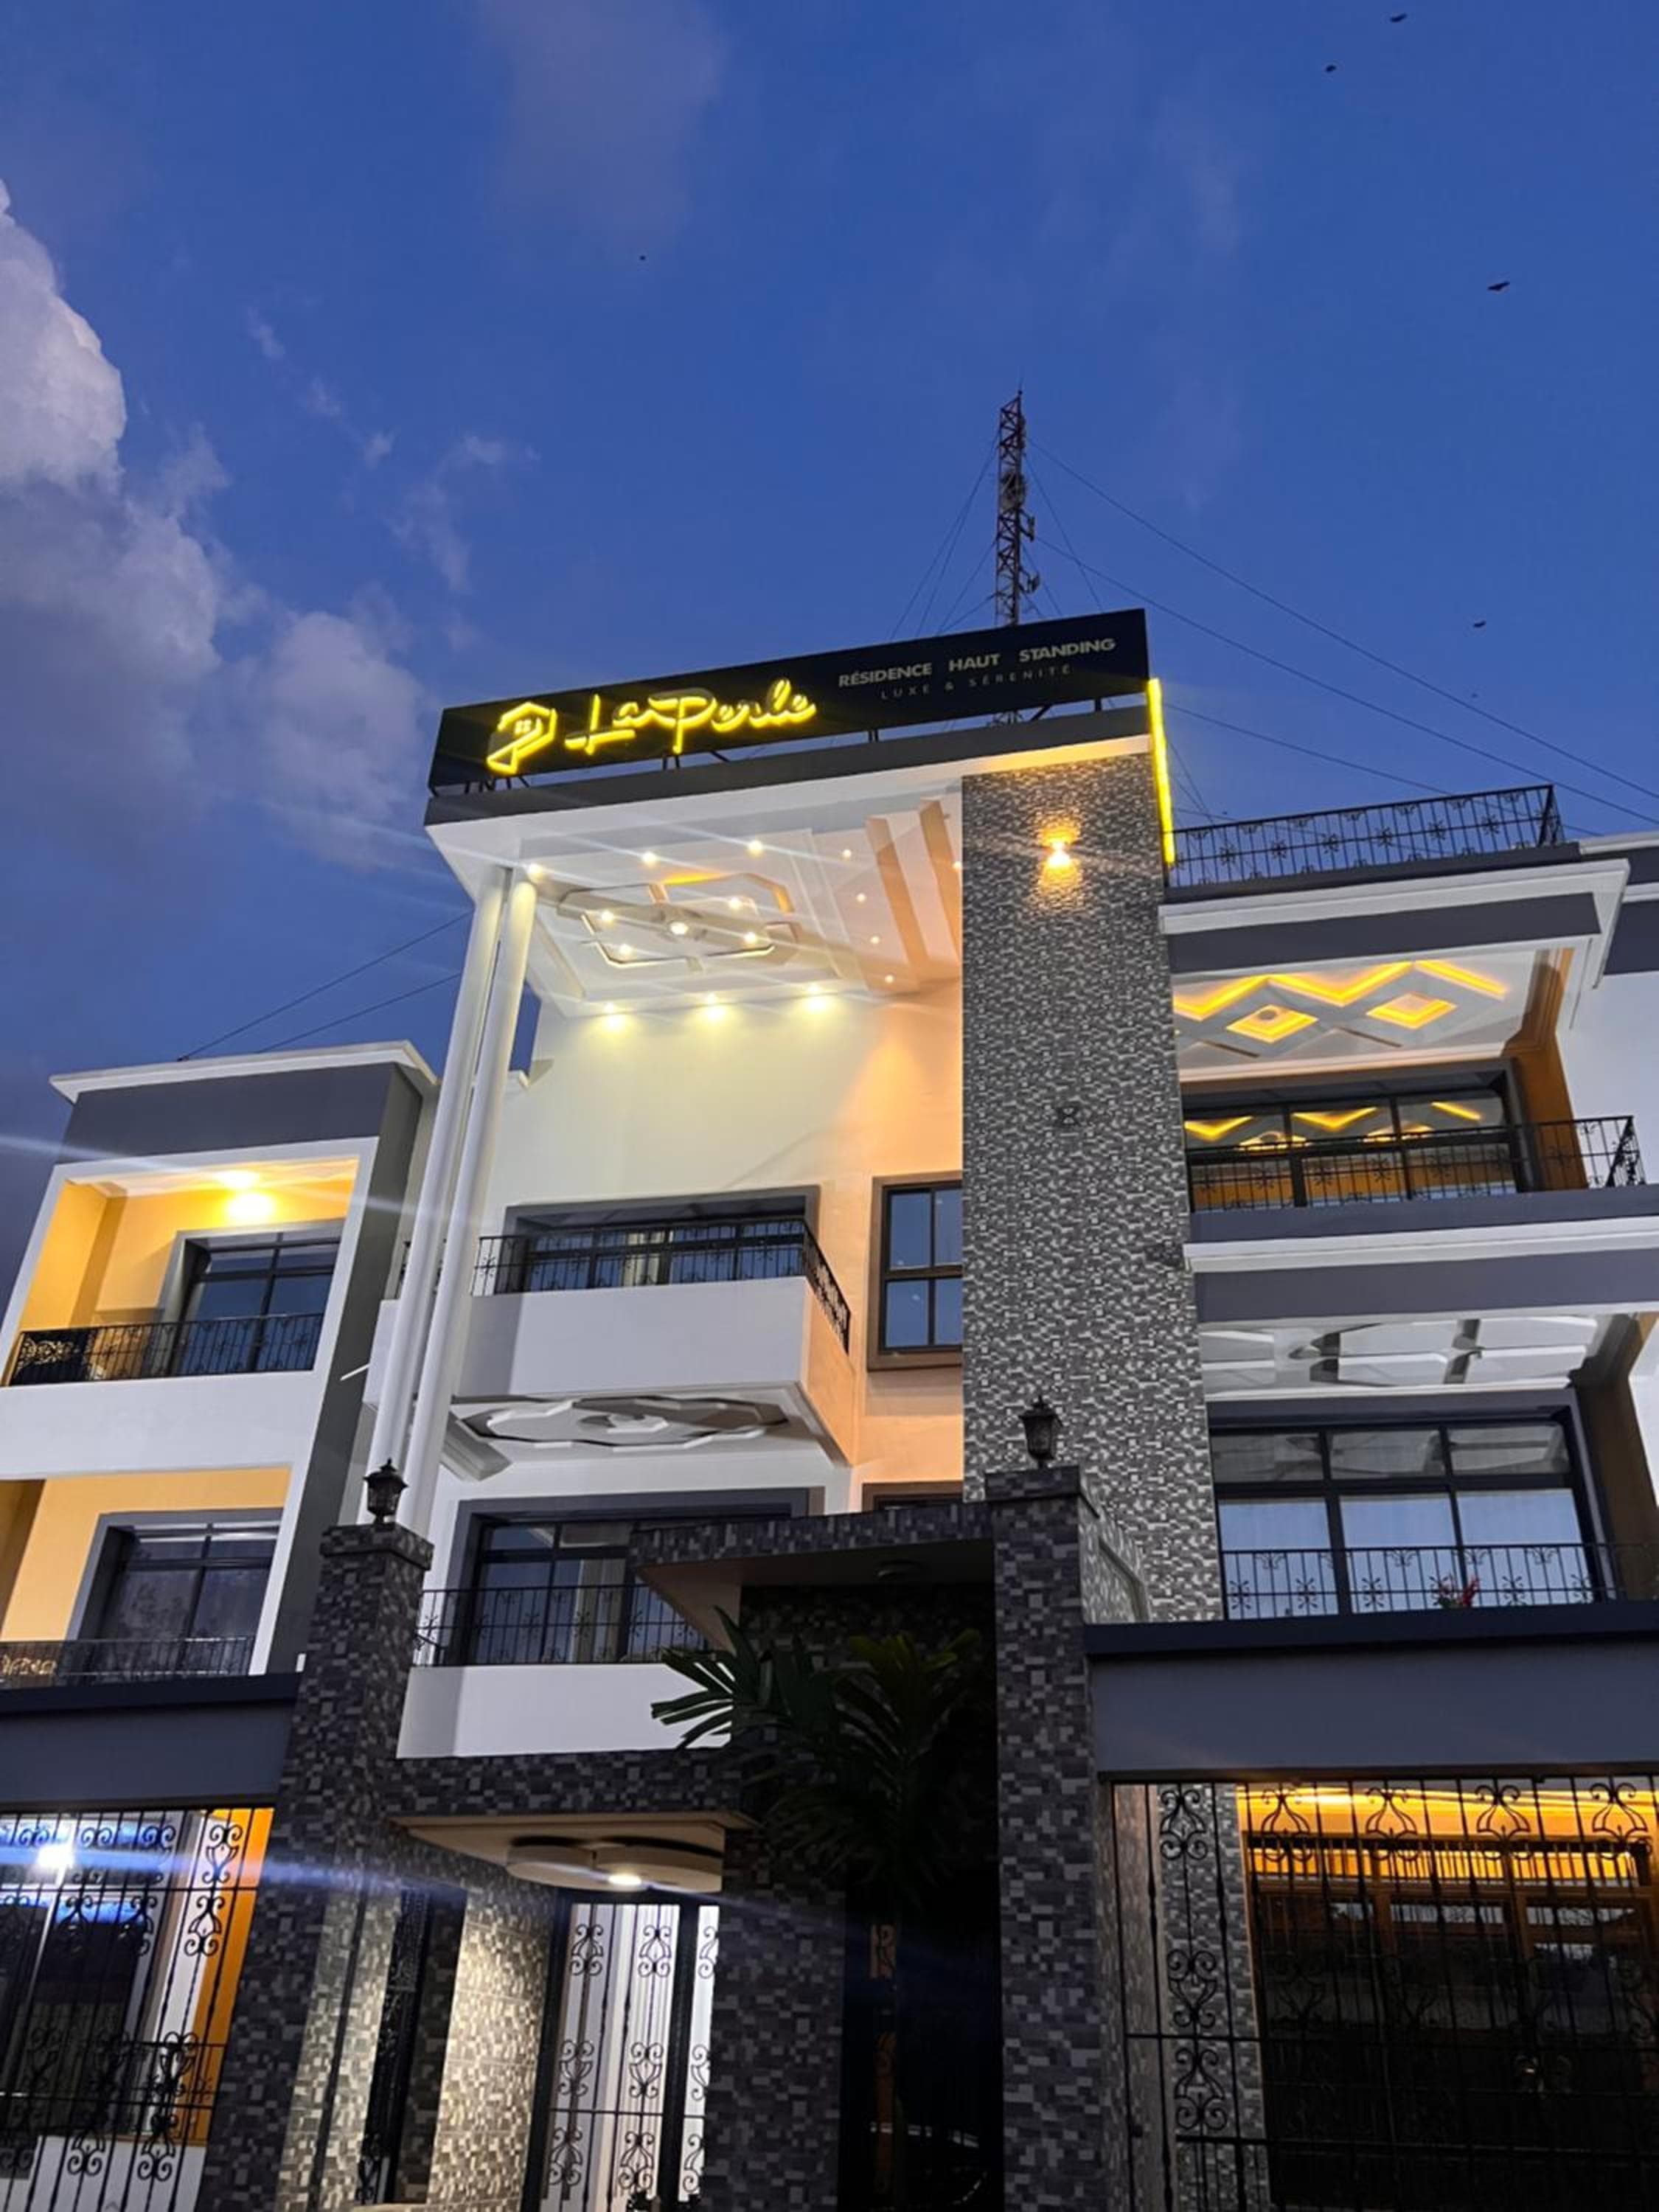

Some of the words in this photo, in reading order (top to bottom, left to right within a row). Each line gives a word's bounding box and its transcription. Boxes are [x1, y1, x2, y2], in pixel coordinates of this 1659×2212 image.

[838, 663, 932, 688] RÉSIDENCE
[949, 653, 1001, 672] HAUT
[1019, 638, 1116, 663] STANDING
[880, 684, 930, 700] LUXE
